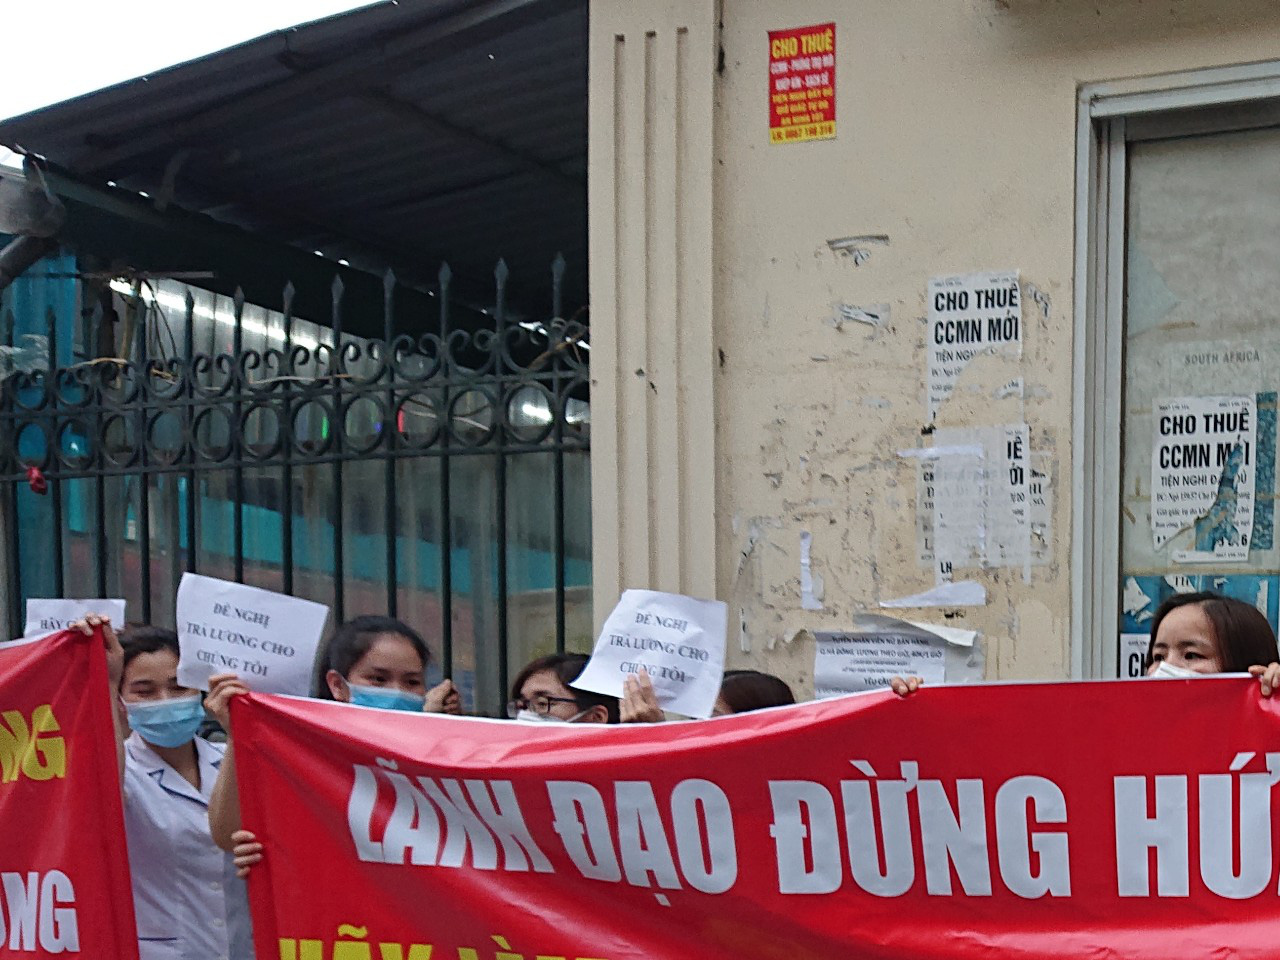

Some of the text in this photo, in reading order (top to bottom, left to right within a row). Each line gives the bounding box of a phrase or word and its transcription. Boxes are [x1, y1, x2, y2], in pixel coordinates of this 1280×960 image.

[772, 37, 799, 59] CHO
[934, 282, 1018, 312] CHO THUÊ
[934, 309, 1019, 345] CCMN MỚI
[1184, 350, 1260, 365] SOUTH AFRICA
[1159, 407, 1249, 437] CHO THUÊ
[1159, 434, 1250, 470] CCMN MI
[1160, 474, 1180, 489] TIỆN
[1182, 475, 1208, 487] NGHI
[236, 607, 272, 629] NGHỊ
[656, 616, 688, 634] NGHỊ
[261, 639, 297, 658] CHO
[678, 646, 711, 662] CHO
[242, 658, 270, 678] TÔI
[349, 757, 555, 874] LÃNH
[545, 777, 740, 906] ĐẠO
[768, 759, 1072, 899] ĐỪNG
[0, 869, 80, 955] NG
